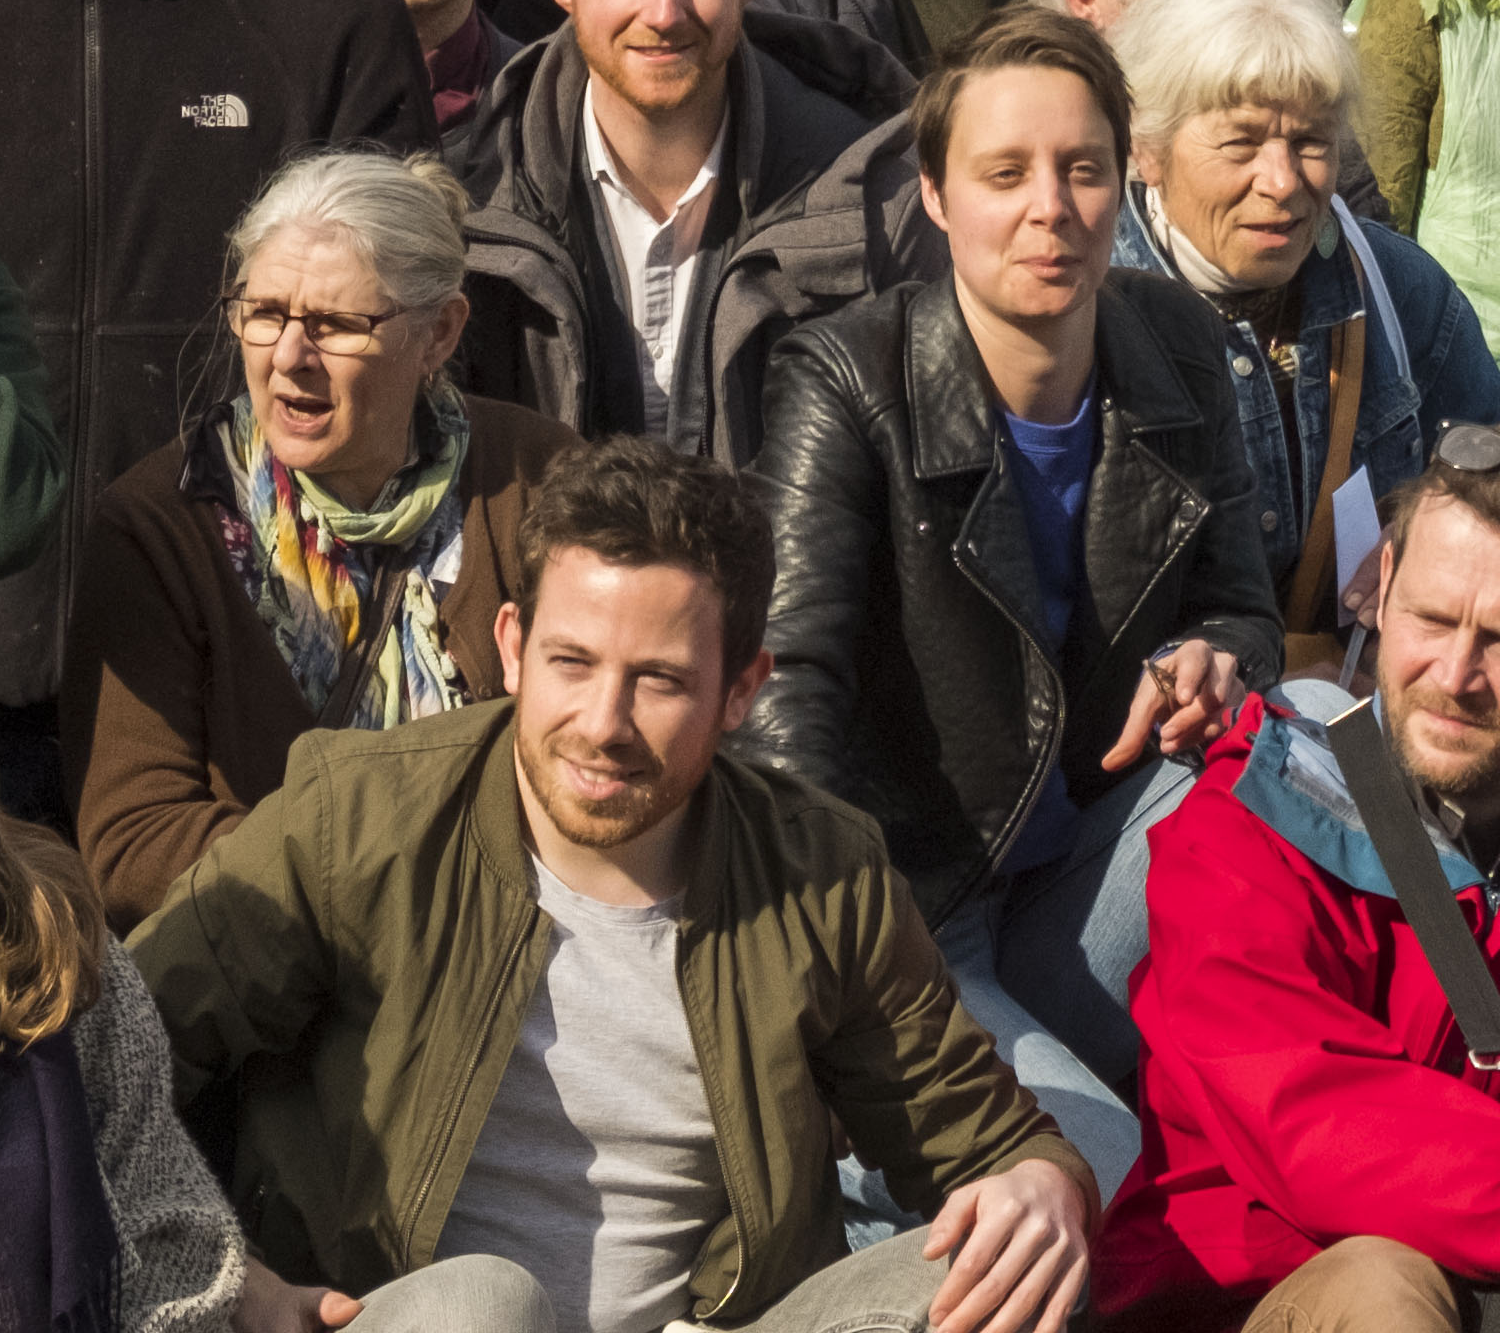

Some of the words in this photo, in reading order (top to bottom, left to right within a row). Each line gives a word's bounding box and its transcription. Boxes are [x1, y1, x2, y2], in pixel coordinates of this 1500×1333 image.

[200, 95, 226, 108] THE
[181, 105, 225, 118] NORTH
[194, 116, 225, 128] FACE
